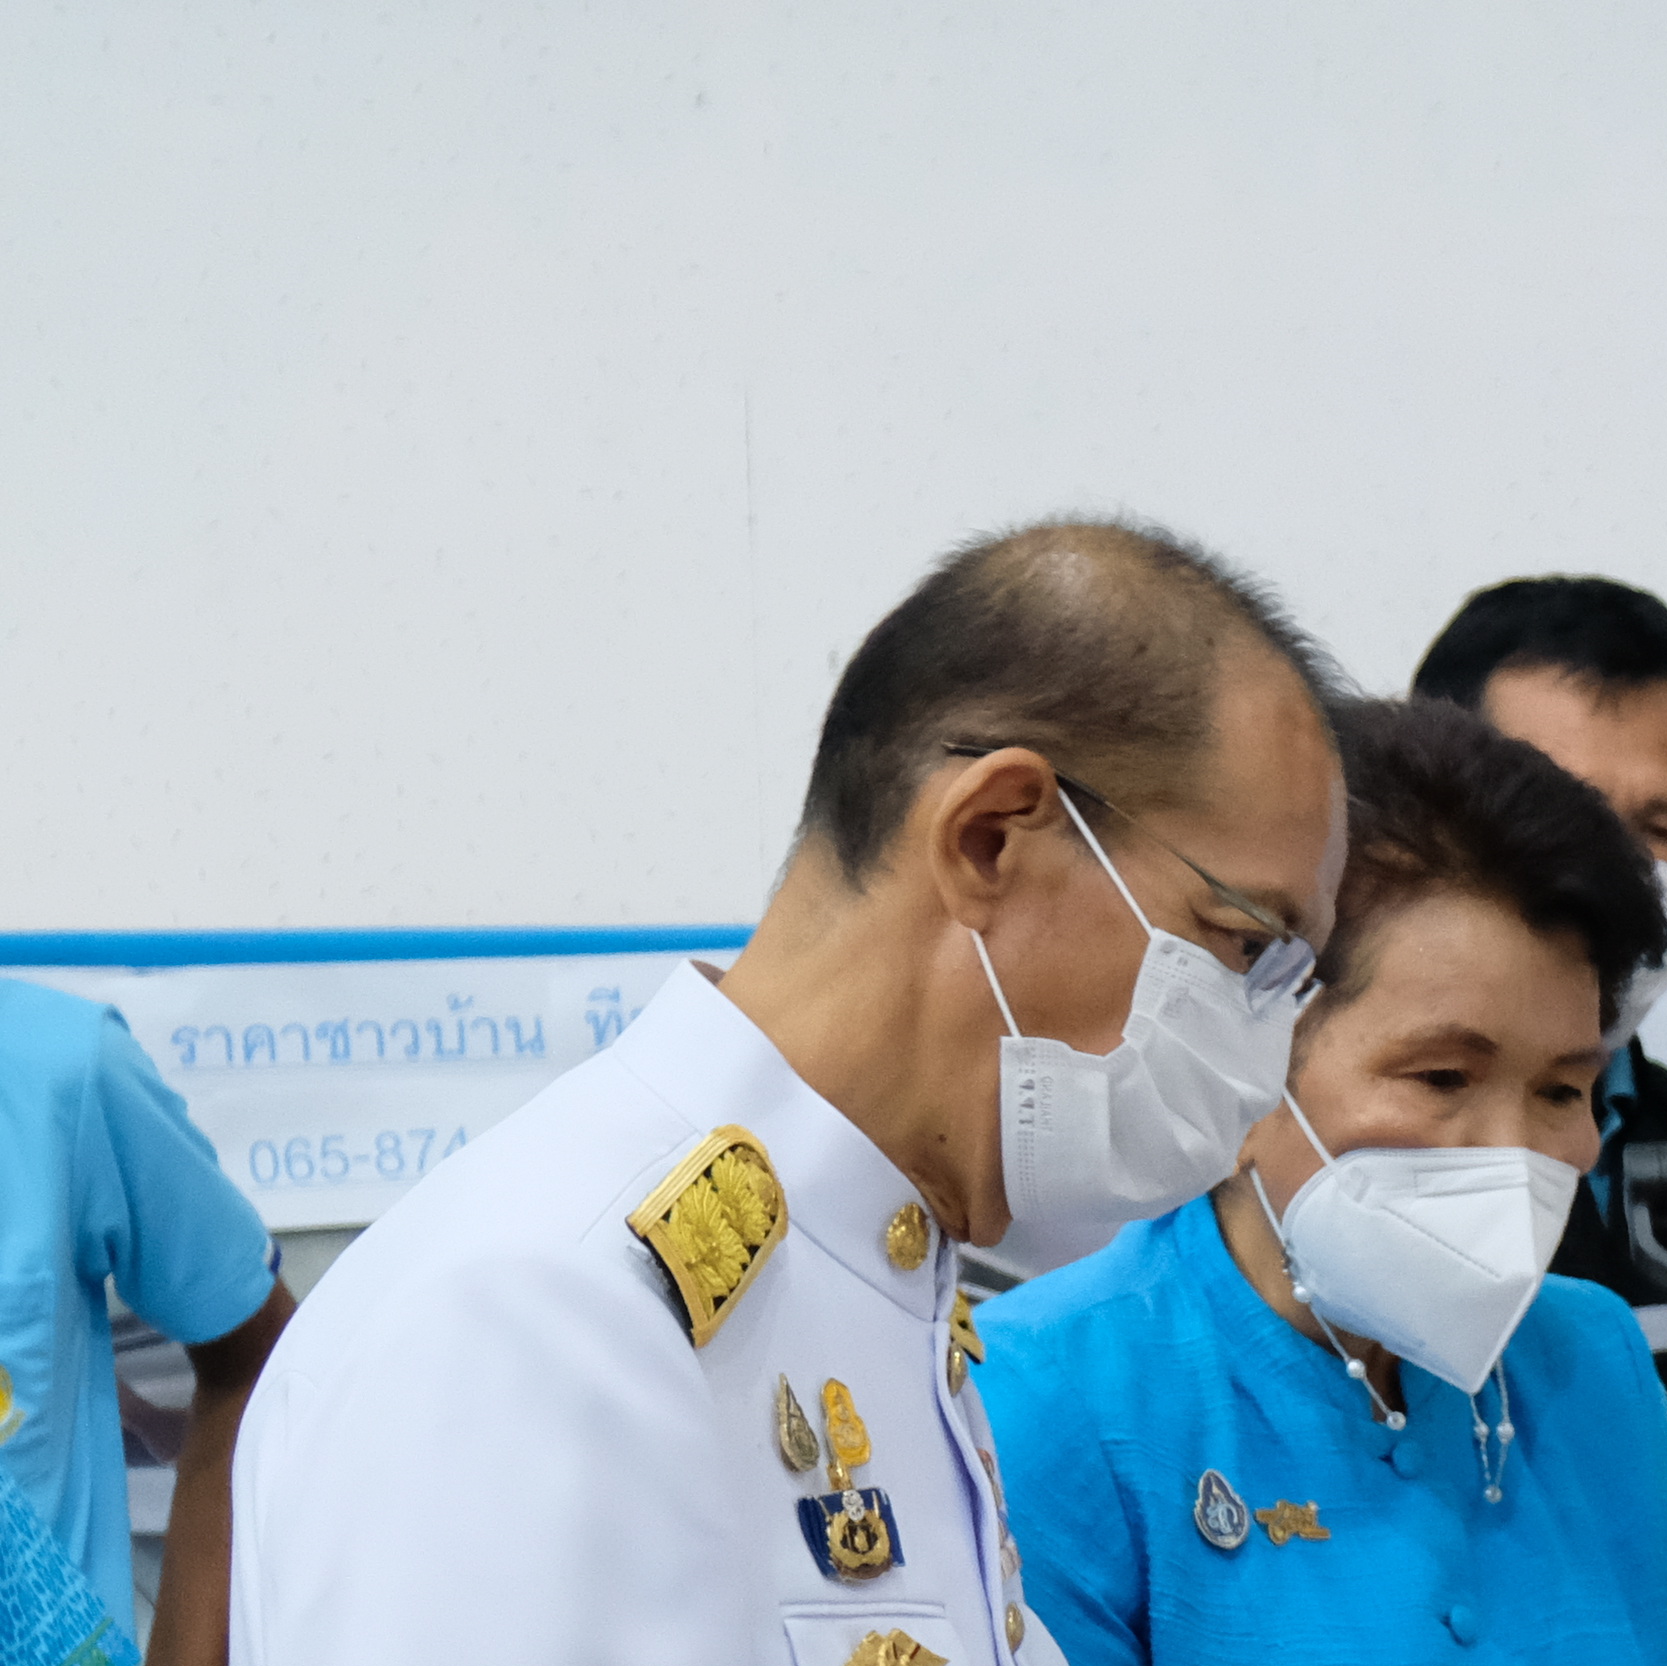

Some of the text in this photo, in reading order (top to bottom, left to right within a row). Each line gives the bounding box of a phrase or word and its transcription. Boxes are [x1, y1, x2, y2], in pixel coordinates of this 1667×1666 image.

[171, 994, 546, 1066] ราคาชาวบ้าน
